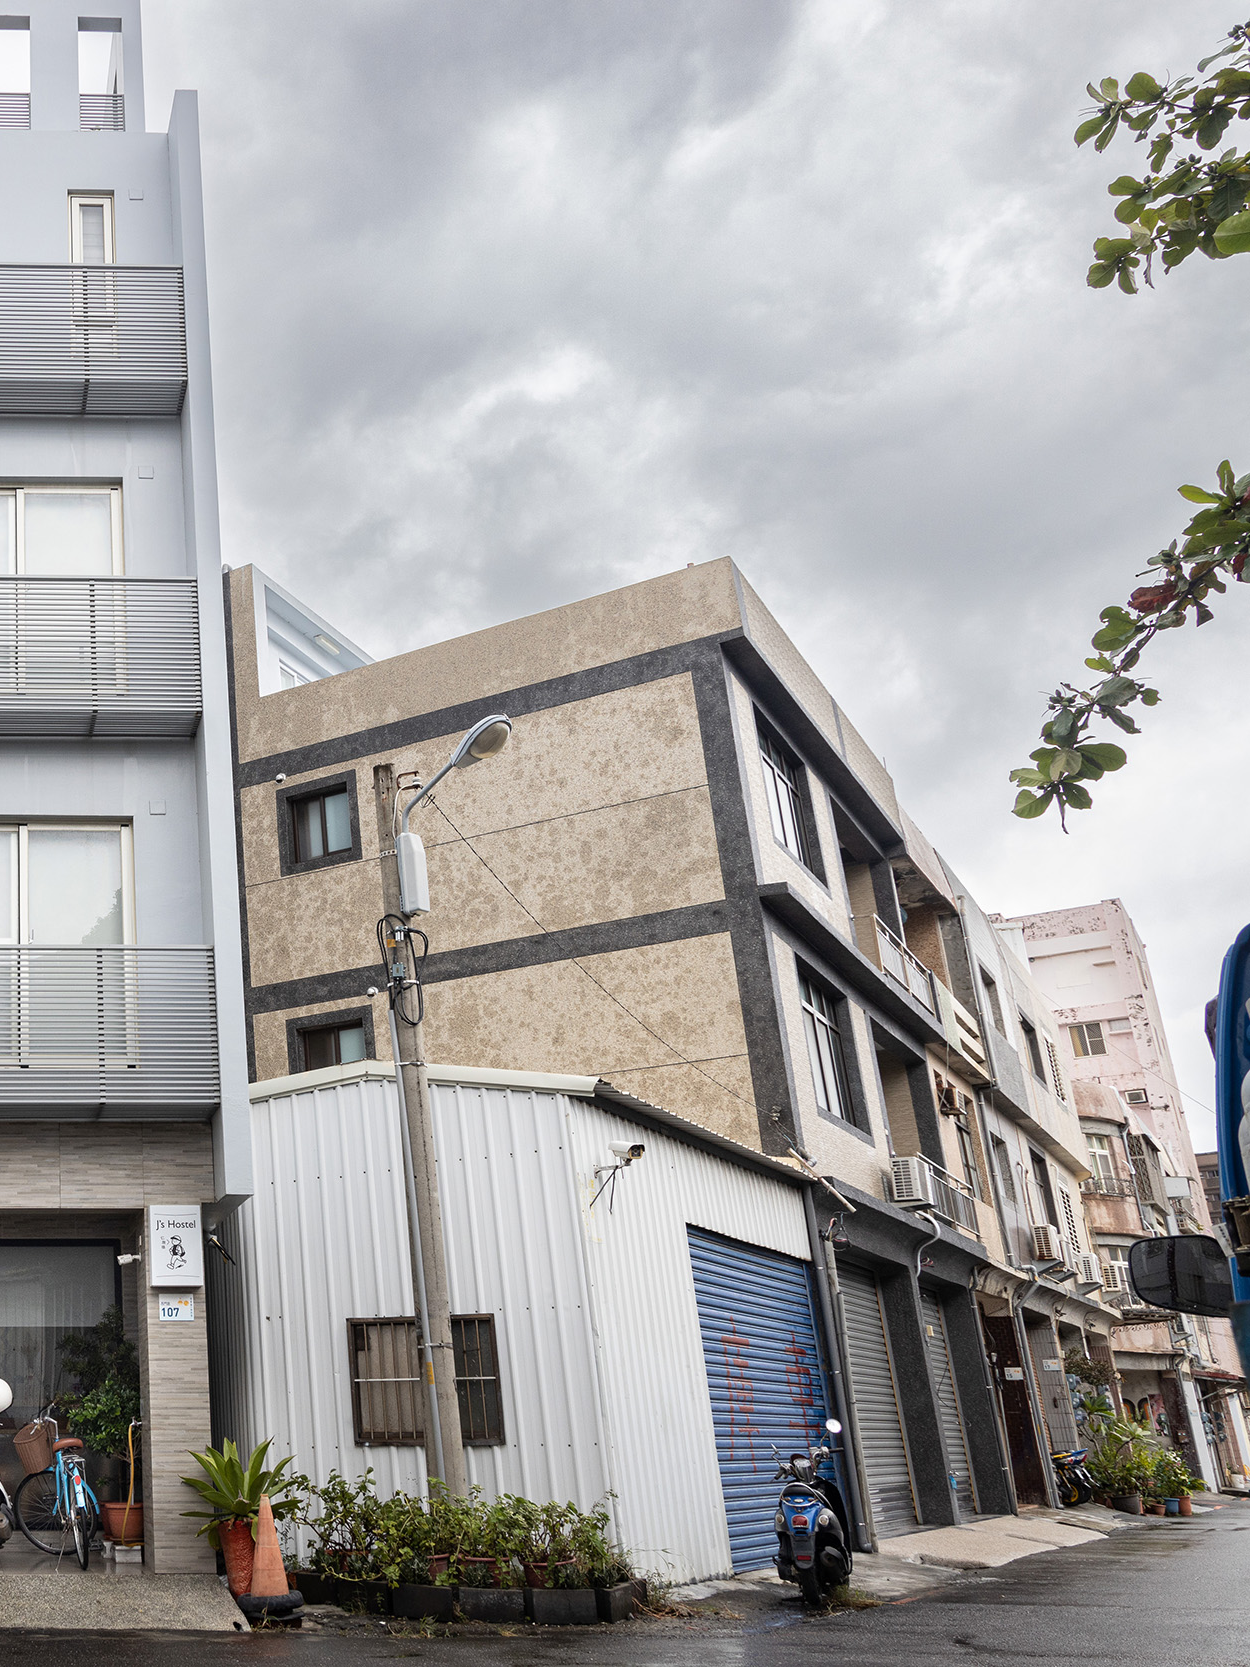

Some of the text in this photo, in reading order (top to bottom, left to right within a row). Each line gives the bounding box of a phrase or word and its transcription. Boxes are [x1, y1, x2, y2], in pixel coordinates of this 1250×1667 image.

[156, 1219, 196, 1230] J's Hostel
[161, 1307, 180, 1318] 107
